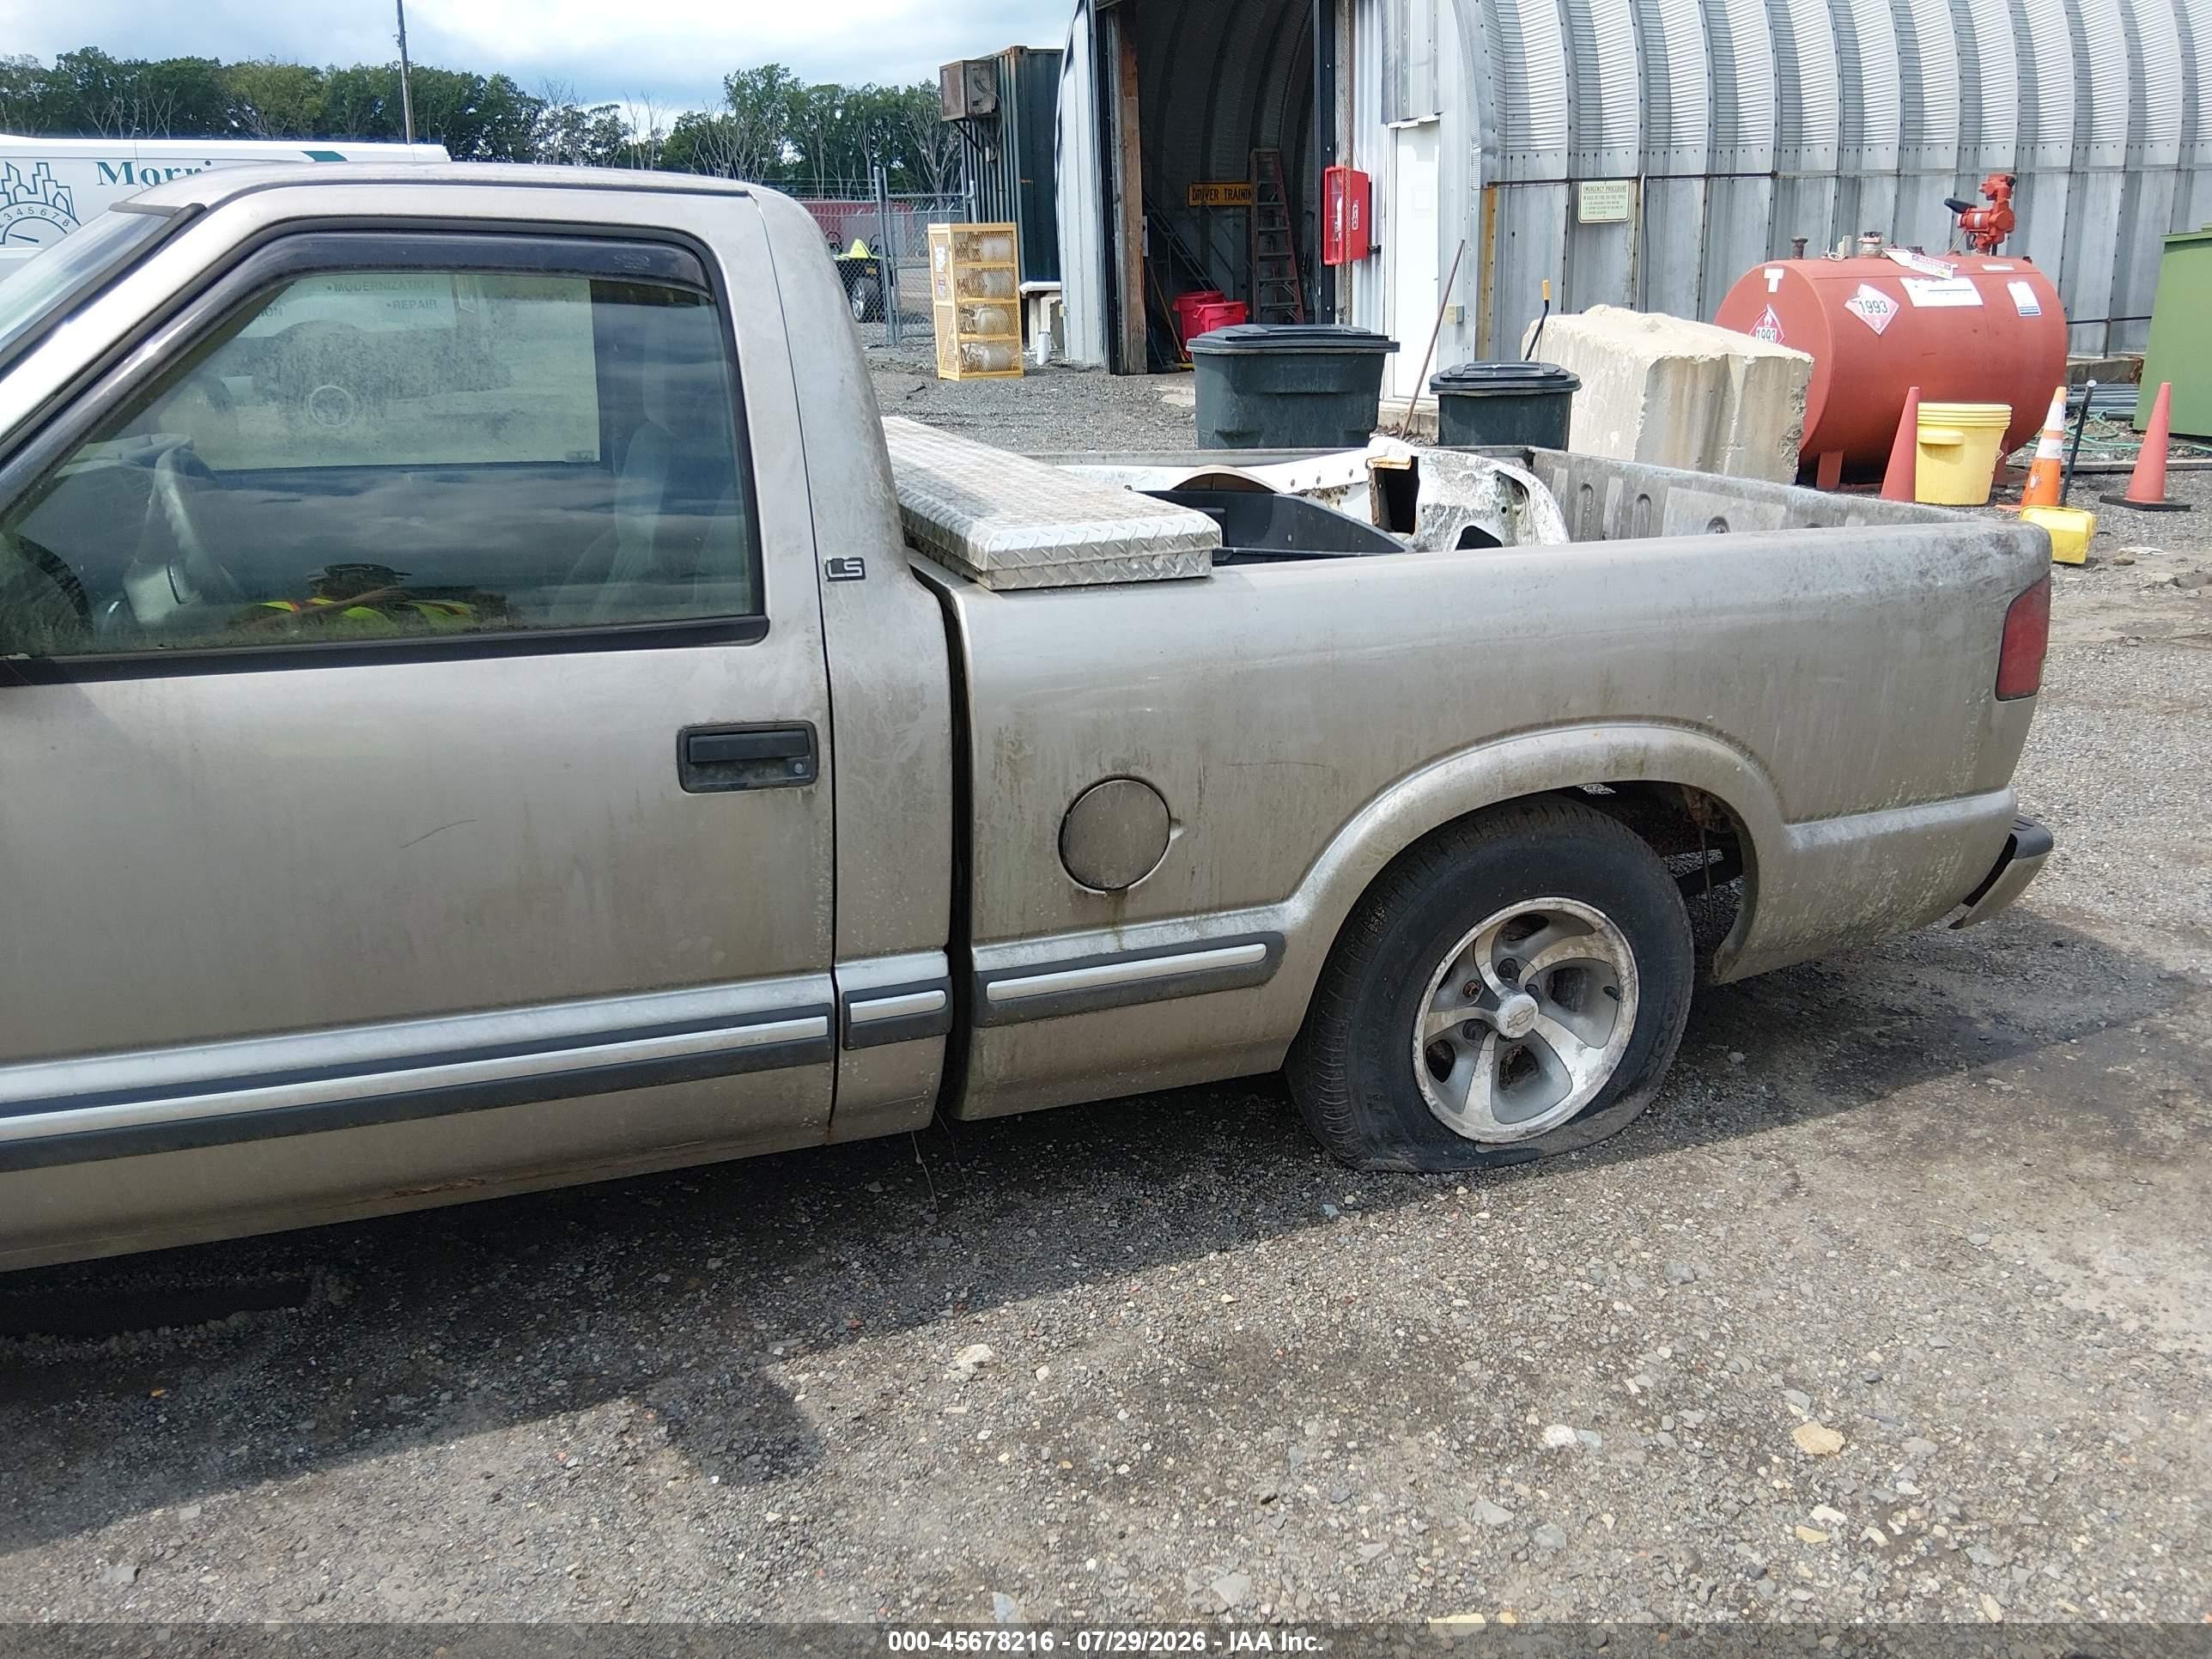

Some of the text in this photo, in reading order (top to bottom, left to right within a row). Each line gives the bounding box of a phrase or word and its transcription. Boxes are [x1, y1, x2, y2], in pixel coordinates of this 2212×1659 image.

[95, 160, 211, 187] Morr
[1192, 188, 1251, 201] DRIVER TRAININ
[40, 208, 47, 216] 6
[334, 280, 435, 292] MODERNIZATION
[392, 300, 437, 310] REPAIR
[1858, 301, 1888, 314] 1993
[1757, 328, 1776, 343] 1993
[827, 561, 863, 578] LS
